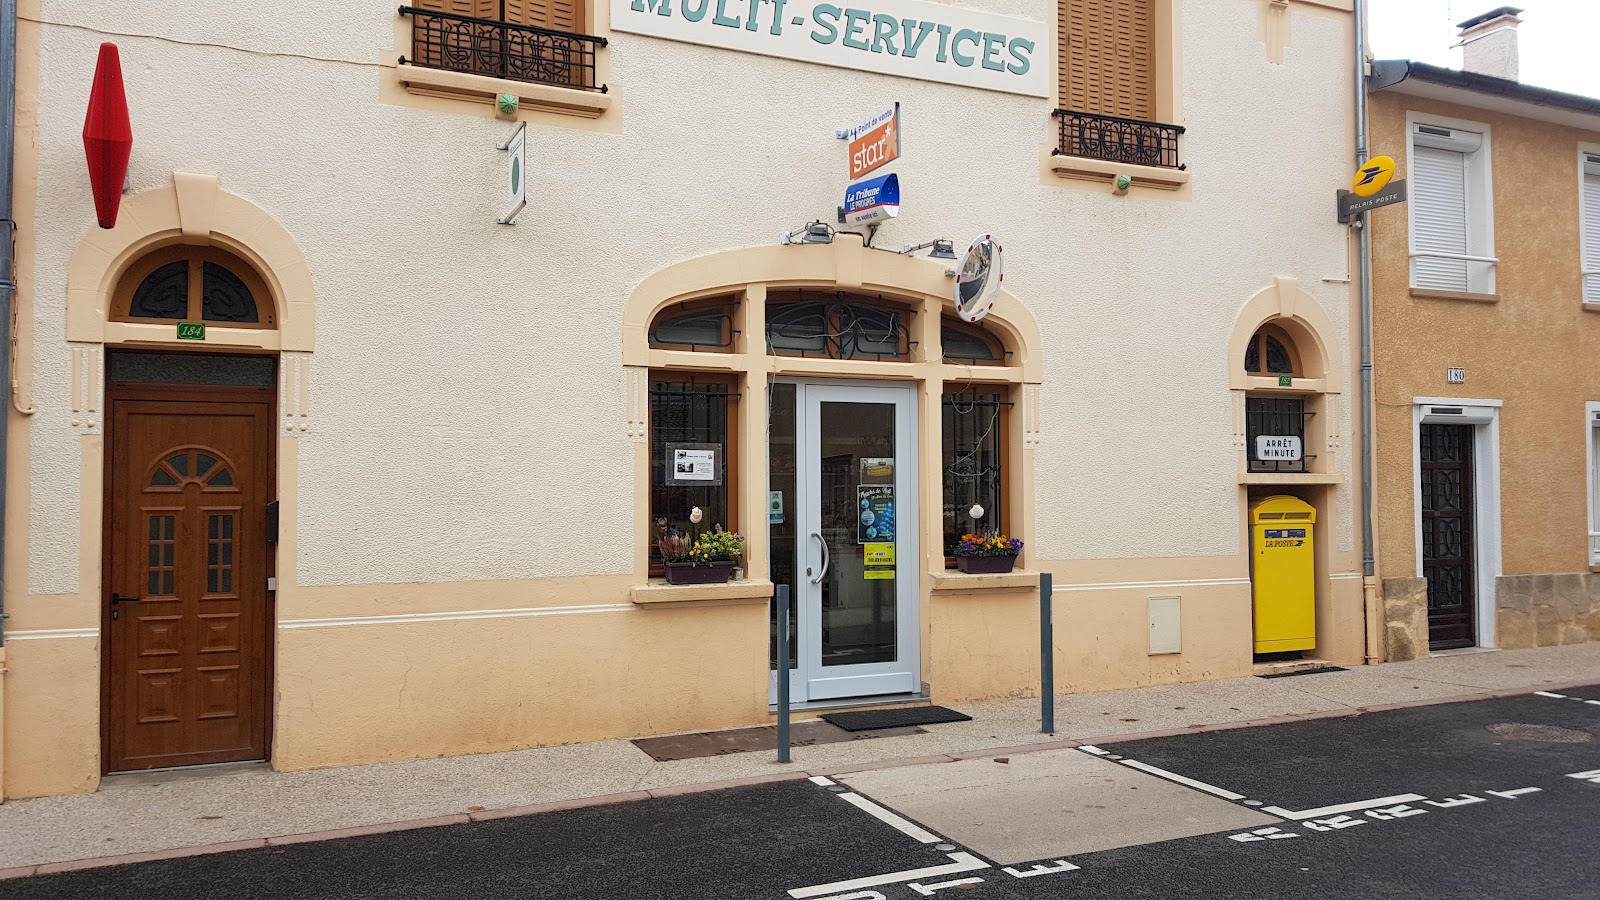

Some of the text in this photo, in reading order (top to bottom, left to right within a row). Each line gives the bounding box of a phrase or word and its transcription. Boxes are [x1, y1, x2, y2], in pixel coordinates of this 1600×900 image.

[857, 109, 893, 134] Point de vente
[847, 187, 880, 203] La Tribune
[1350, 193, 1398, 210] RELAIS POSTE
[181, 326, 202, 336] 184
[1449, 370, 1465, 381] 180
[1266, 438, 1292, 448] ARRÊT
[1263, 449, 1295, 457] MINUTE
